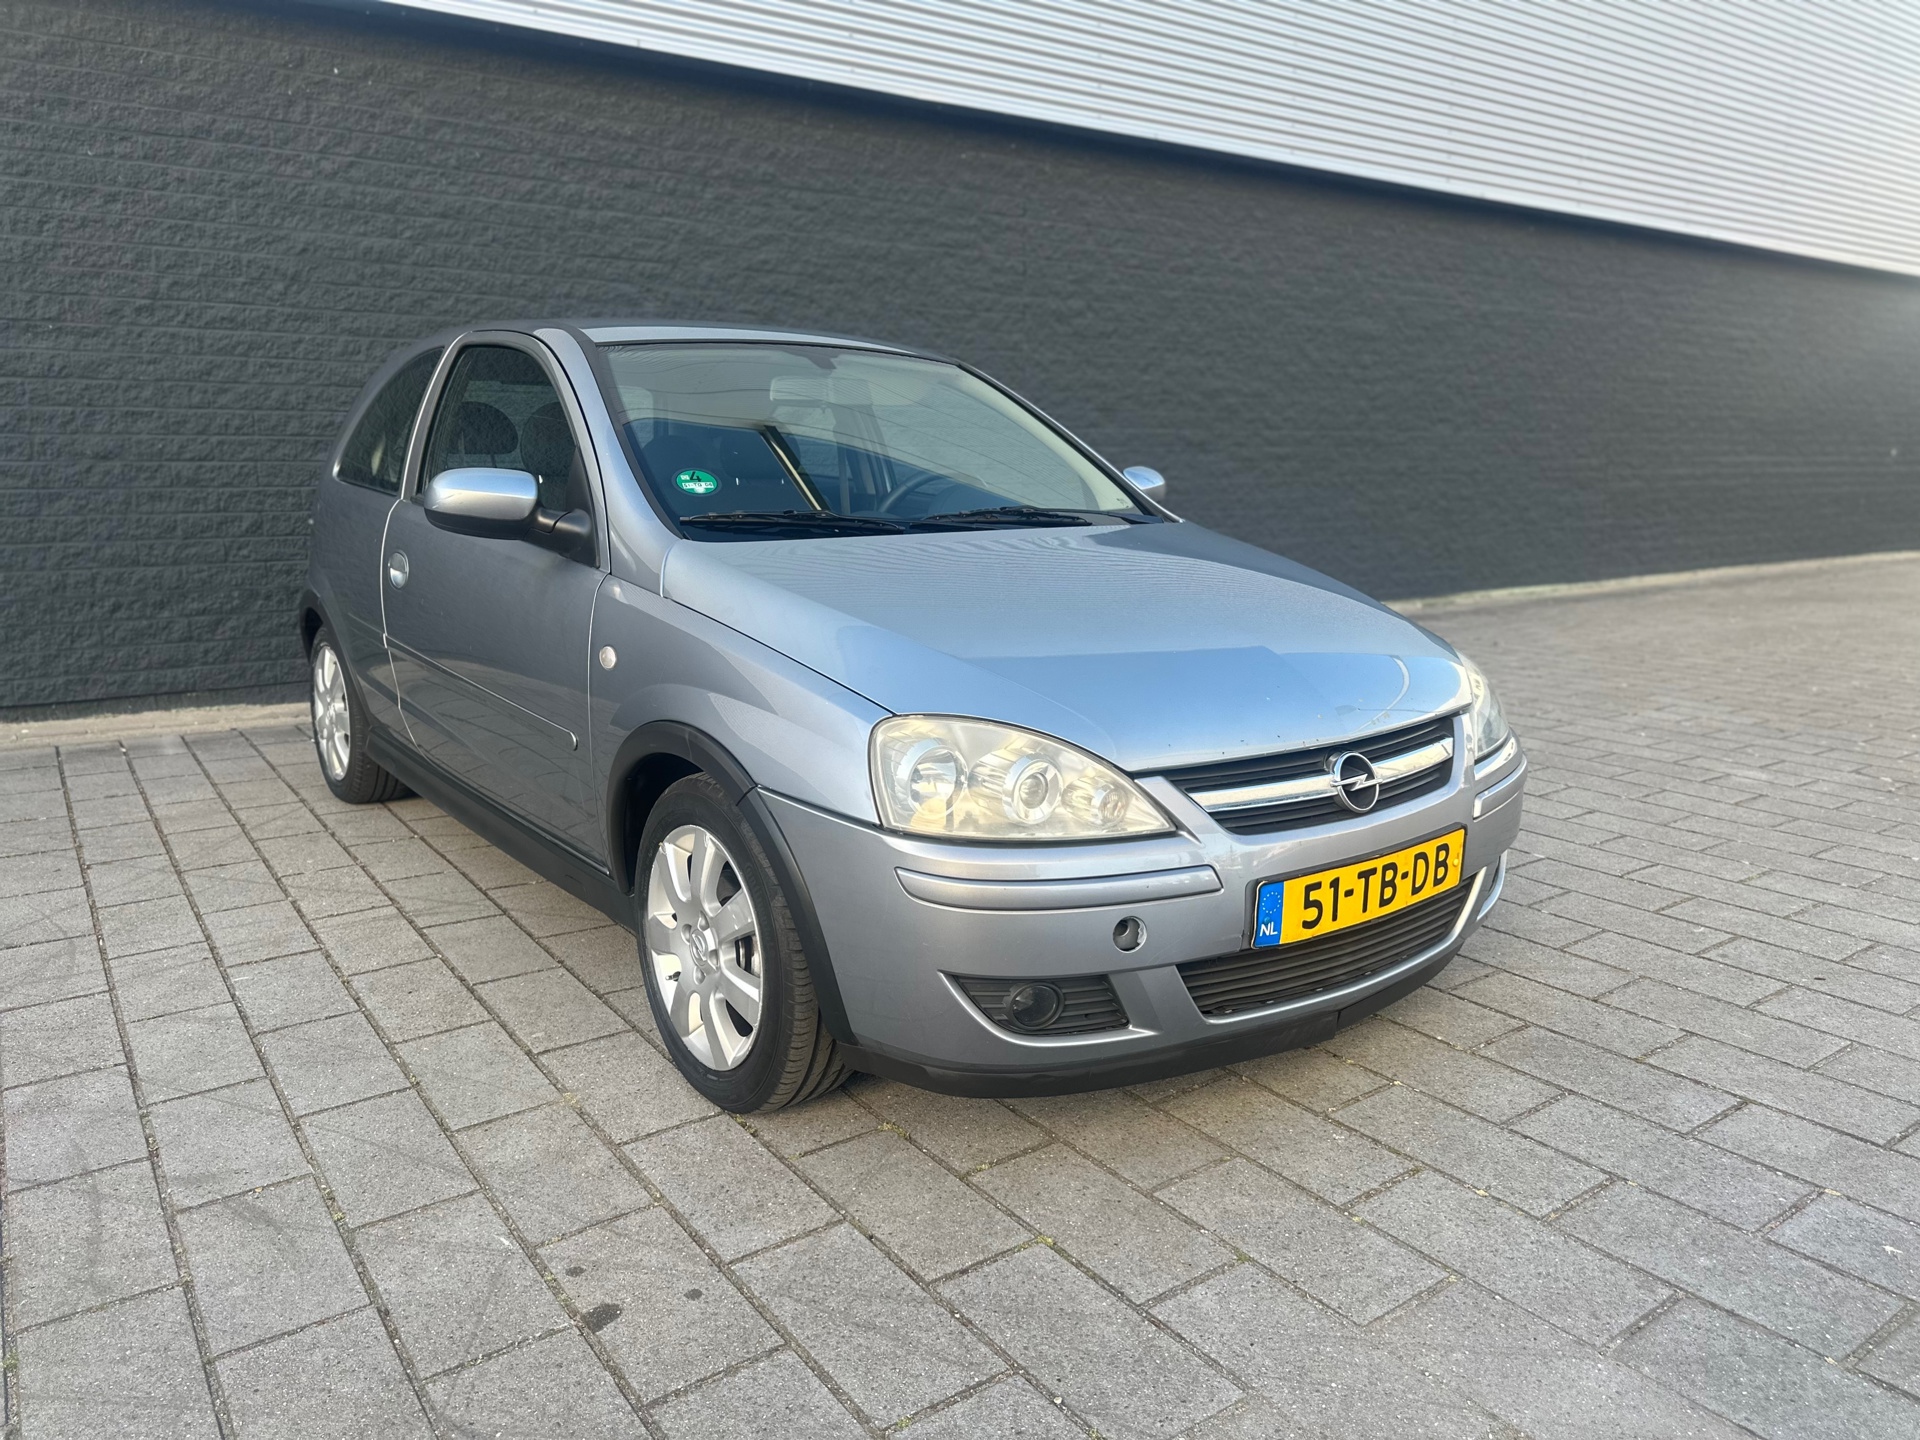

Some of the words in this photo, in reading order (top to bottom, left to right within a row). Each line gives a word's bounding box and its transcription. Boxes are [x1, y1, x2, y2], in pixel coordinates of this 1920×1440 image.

[690, 471, 702, 482] 4
[1301, 843, 1450, 930] 51-TB-DB
[1259, 921, 1278, 937] NL
